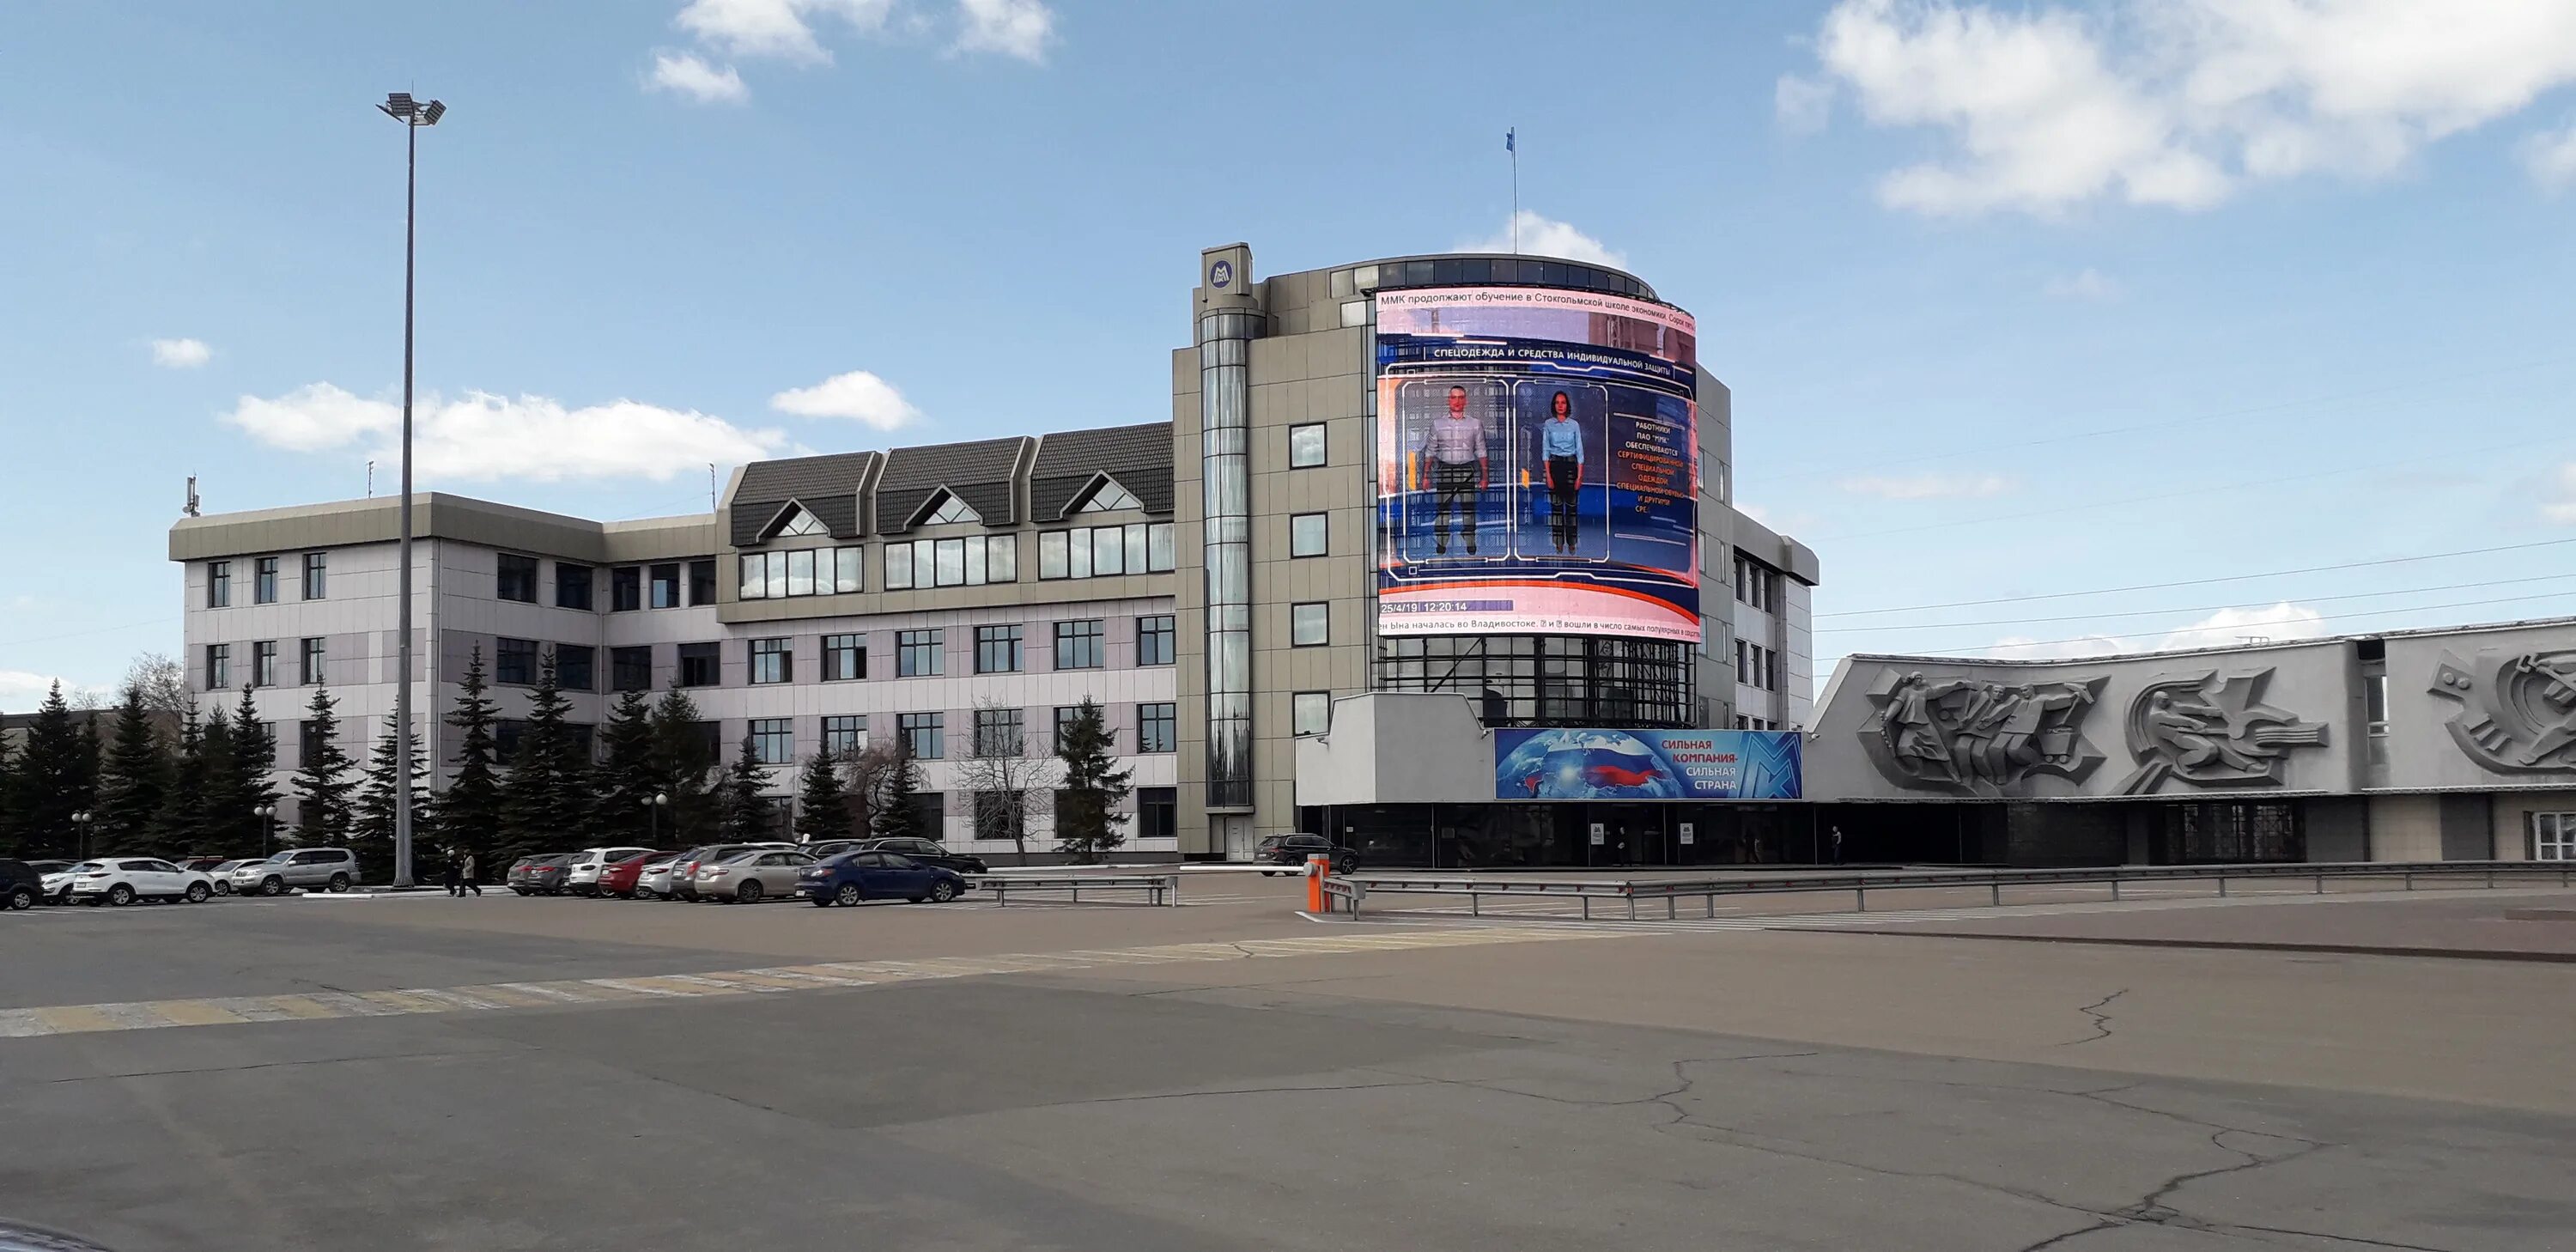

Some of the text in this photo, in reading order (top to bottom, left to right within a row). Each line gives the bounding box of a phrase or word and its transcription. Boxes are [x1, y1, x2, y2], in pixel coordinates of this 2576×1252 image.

[1381, 295, 1406, 305] ММК
[1408, 294, 1472, 305] продолжают
[1475, 292, 1522, 301] обучение
[1535, 293, 1602, 307] Стокгольмской
[1605, 302, 1630, 311] школе
[1434, 349, 1504, 357] СПЕЦОДЕЖДА
[1518, 349, 1564, 359] СРЕДСТВА
[1567, 352, 1643, 369] ИНДИВИДУАЛЬНОЙ
[1644, 362, 1670, 375] ЗАЩИТЫ
[1636, 422, 1670, 434] РАБОТНИКИ
[1637, 432, 1650, 441] ПАО
[1625, 441, 1678, 457] ОБЕСПЕЧИВАЮТСЯ
[1644, 495, 1670, 506] ДРУГИМИ
[1424, 602, 1467, 611] 12:20:14
[1471, 620, 1539, 629] Владивостоке.
[1646, 625, 1680, 636] популярных
[1662, 739, 1712, 750] СИЛЬНАЯ
[1673, 753, 1738, 763] КОМПАНИЯ-
[1686, 767, 1736, 776] СИЛЬНАЯ
[1694, 780, 1737, 790] СТРАНА
